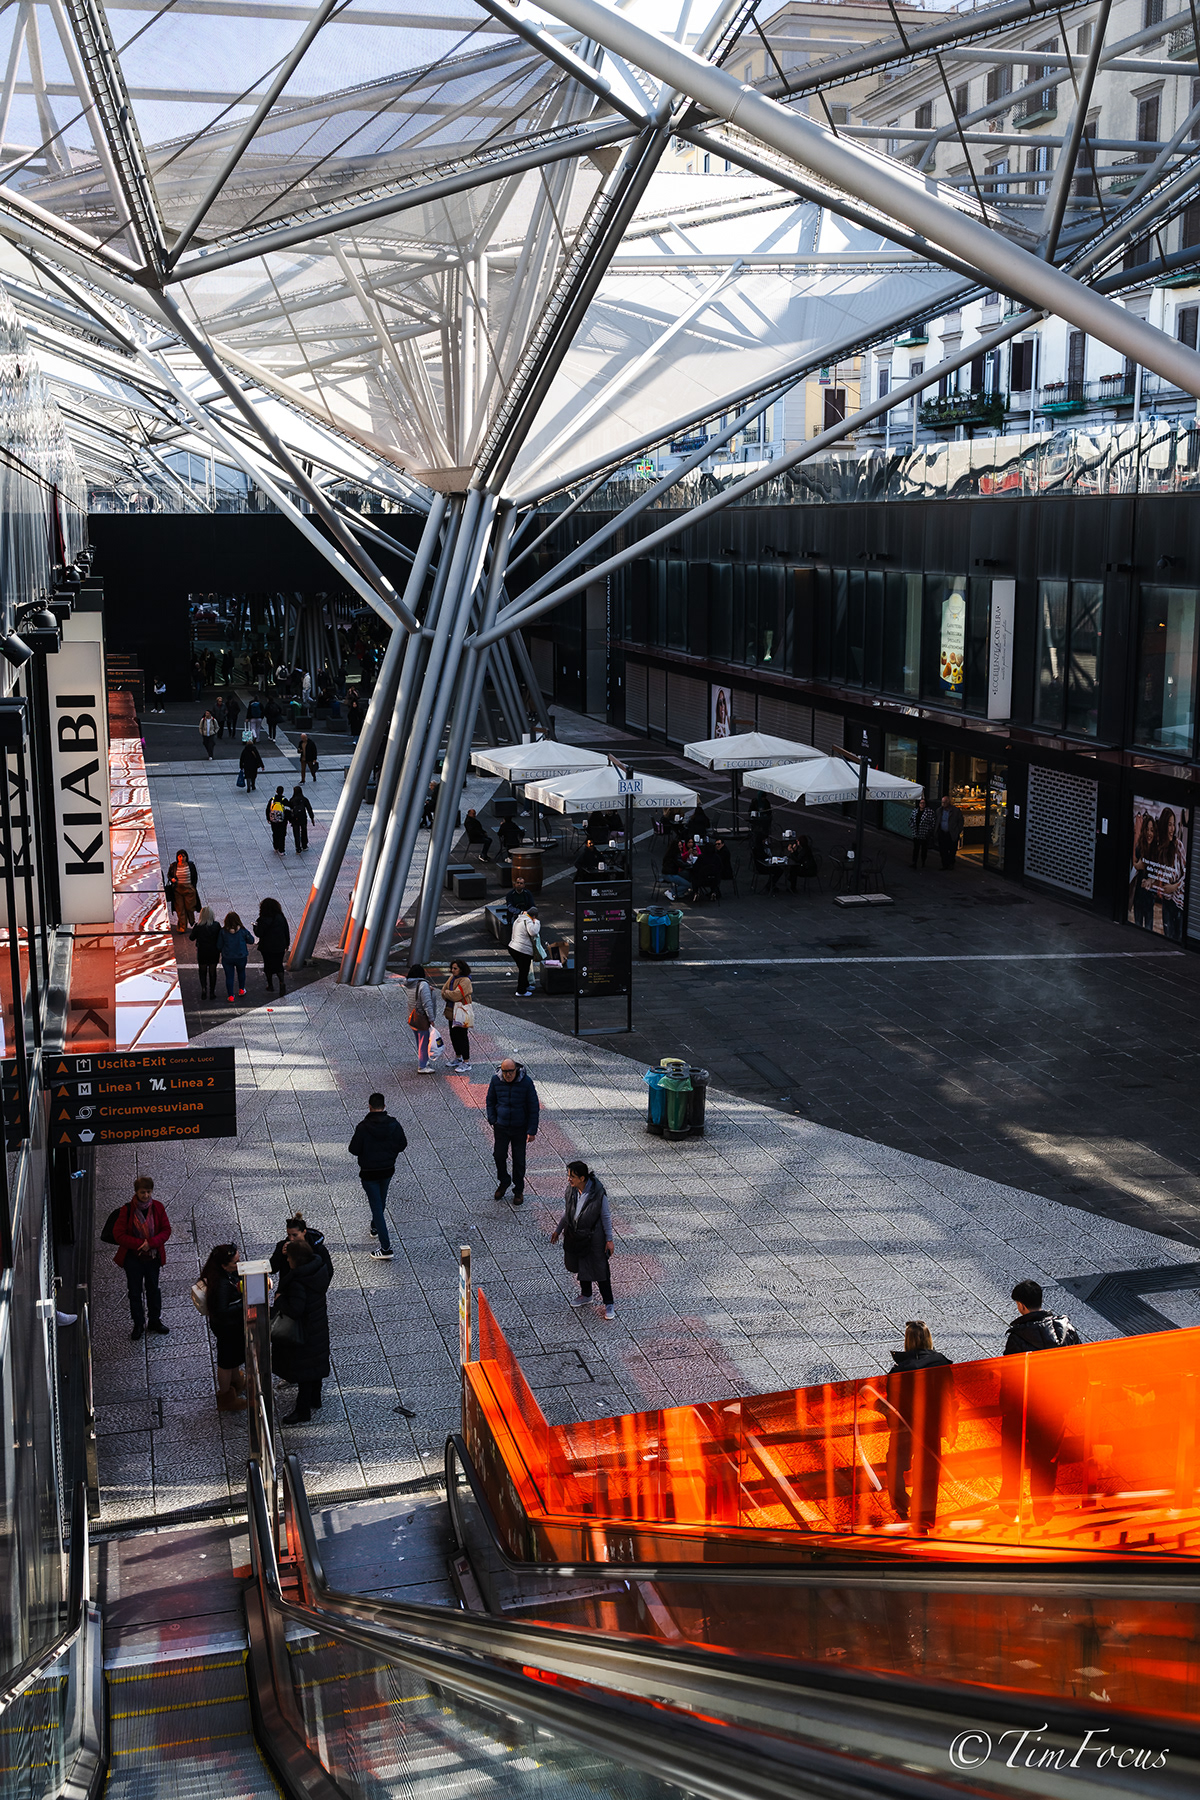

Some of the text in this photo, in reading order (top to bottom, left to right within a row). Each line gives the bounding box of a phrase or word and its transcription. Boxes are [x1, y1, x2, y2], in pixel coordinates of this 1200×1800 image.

[993, 608, 1002, 644] COSTIERA
[727, 760, 773, 768] ECCELLENZE
[525, 769, 572, 779] ECCELLENZE
[56, 695, 104, 875] KIABI
[619, 781, 642, 793] BAR
[817, 791, 909, 803] ECCELLEN COSTIERA
[580, 798, 683, 811] ECCELLEN COSTIERA
[97, 1057, 167, 1070] Uscita-Exit
[98, 1082, 132, 1093] Linea
[136, 1081, 141, 1091] 1
[170, 1078, 203, 1089] Linea
[207, 1077, 215, 1087] 2
[99, 1102, 204, 1117] Circumvesuviana
[100, 1124, 200, 1141] Shopping&Food
